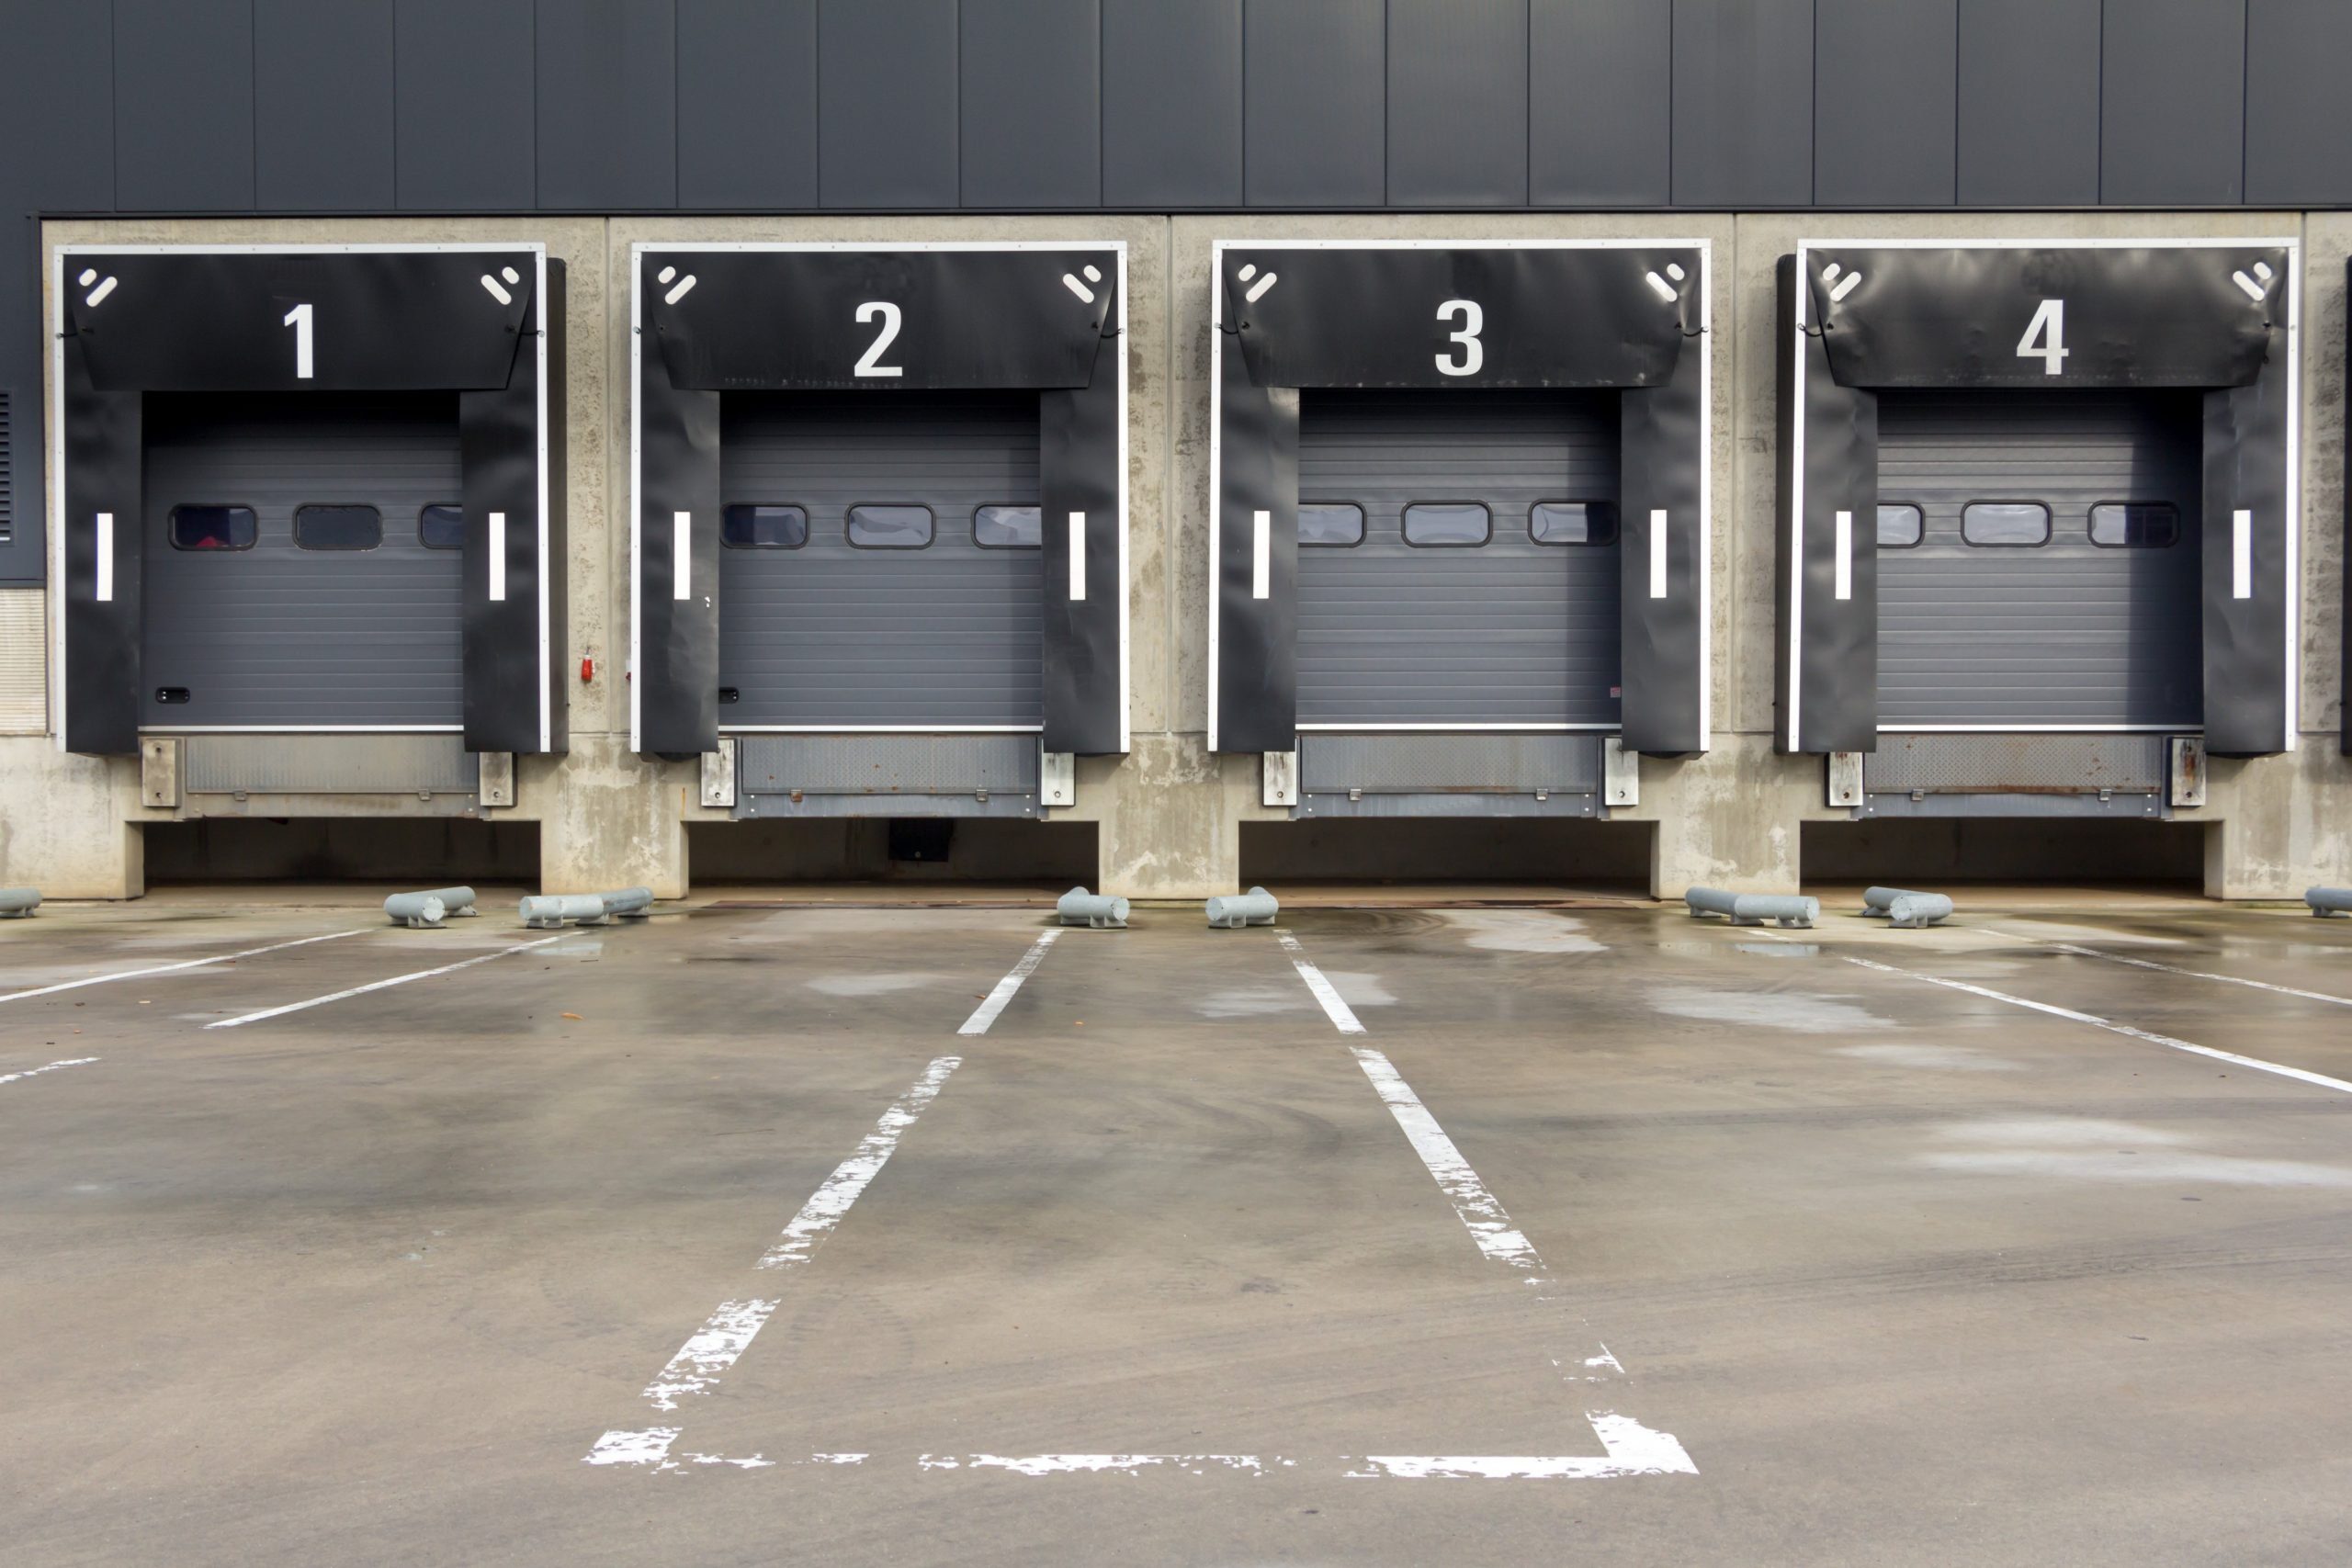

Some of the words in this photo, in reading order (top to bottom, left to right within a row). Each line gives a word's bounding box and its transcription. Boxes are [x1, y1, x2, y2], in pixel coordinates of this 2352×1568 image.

[284, 303, 313, 378] 1
[854, 301, 903, 378] 2
[1435, 299, 1484, 377] 3
[2016, 299, 2069, 376] 4
